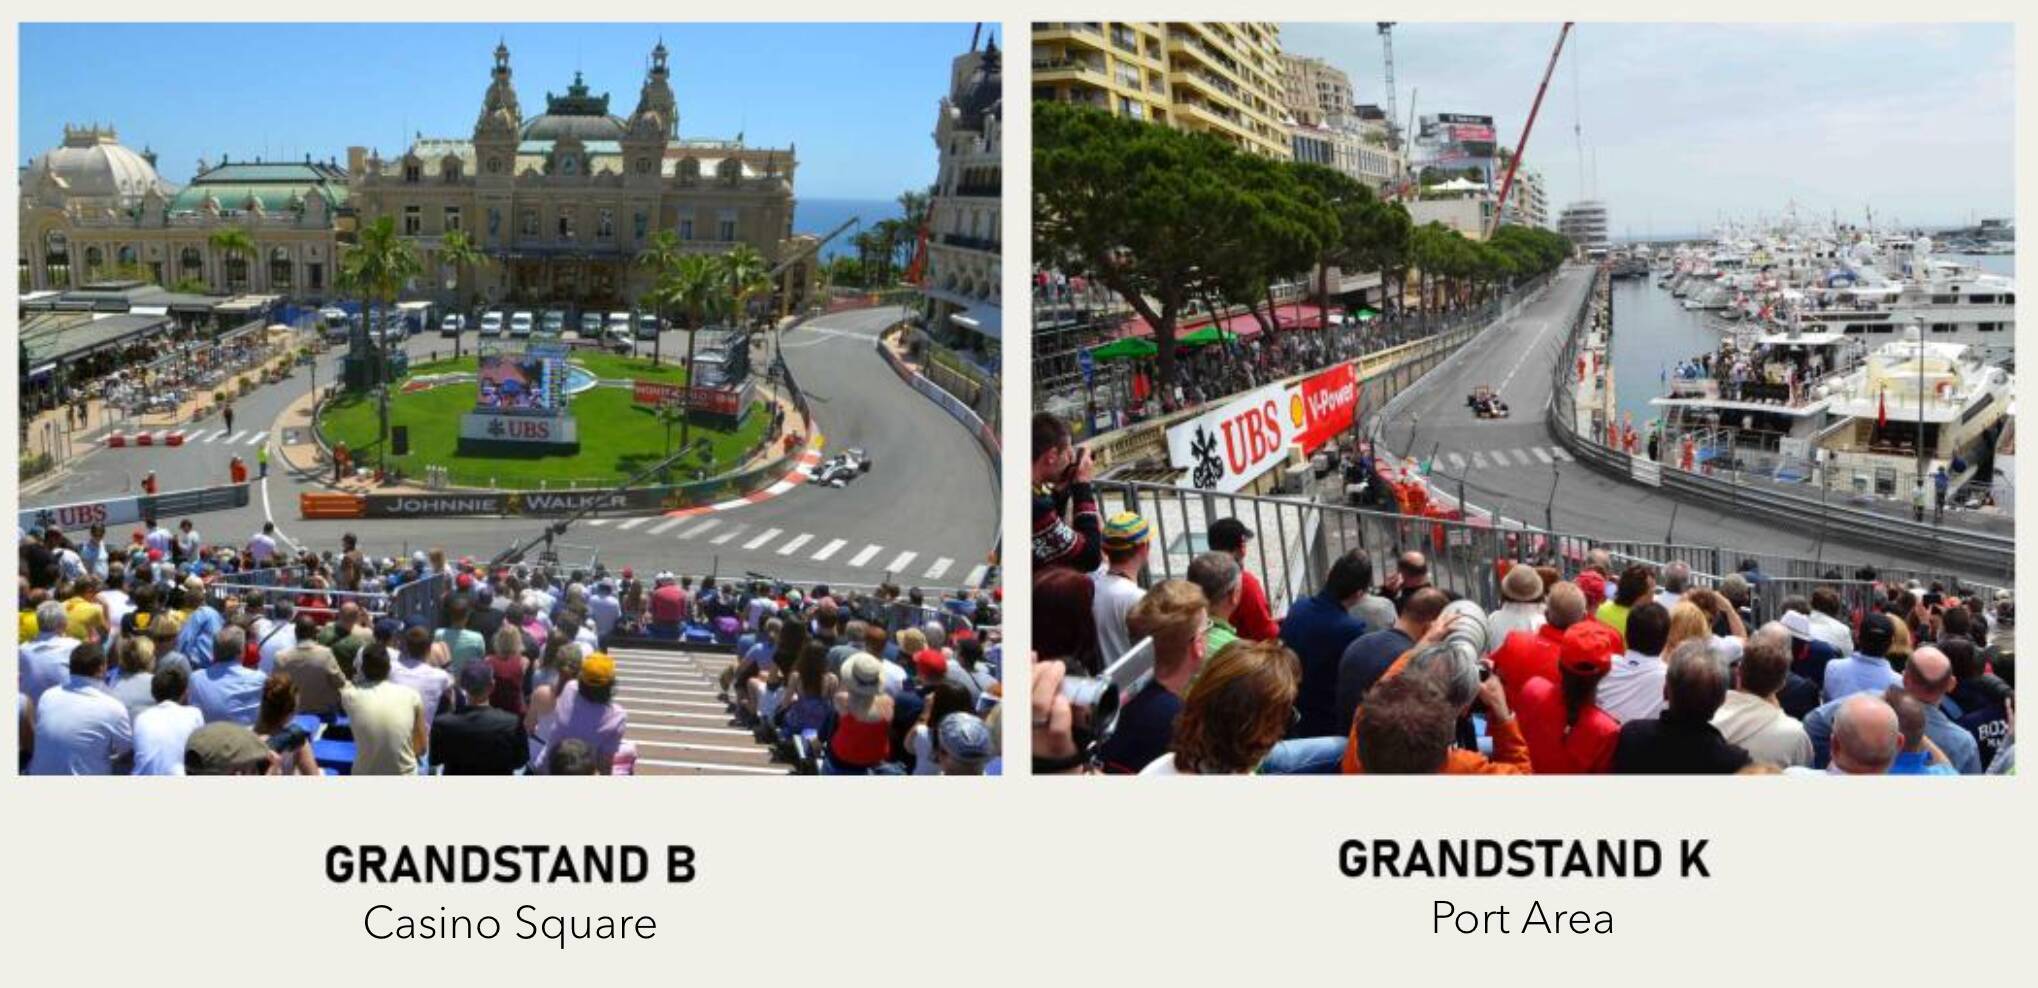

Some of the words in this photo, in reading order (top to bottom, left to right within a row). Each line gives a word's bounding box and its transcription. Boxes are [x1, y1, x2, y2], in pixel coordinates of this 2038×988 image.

[1307, 382, 1353, 421] V-Power
[508, 420, 549, 438] UBS
[1220, 399, 1281, 475] UBS
[59, 503, 107, 526] UBS
[386, 498, 497, 512] JOHNNIE
